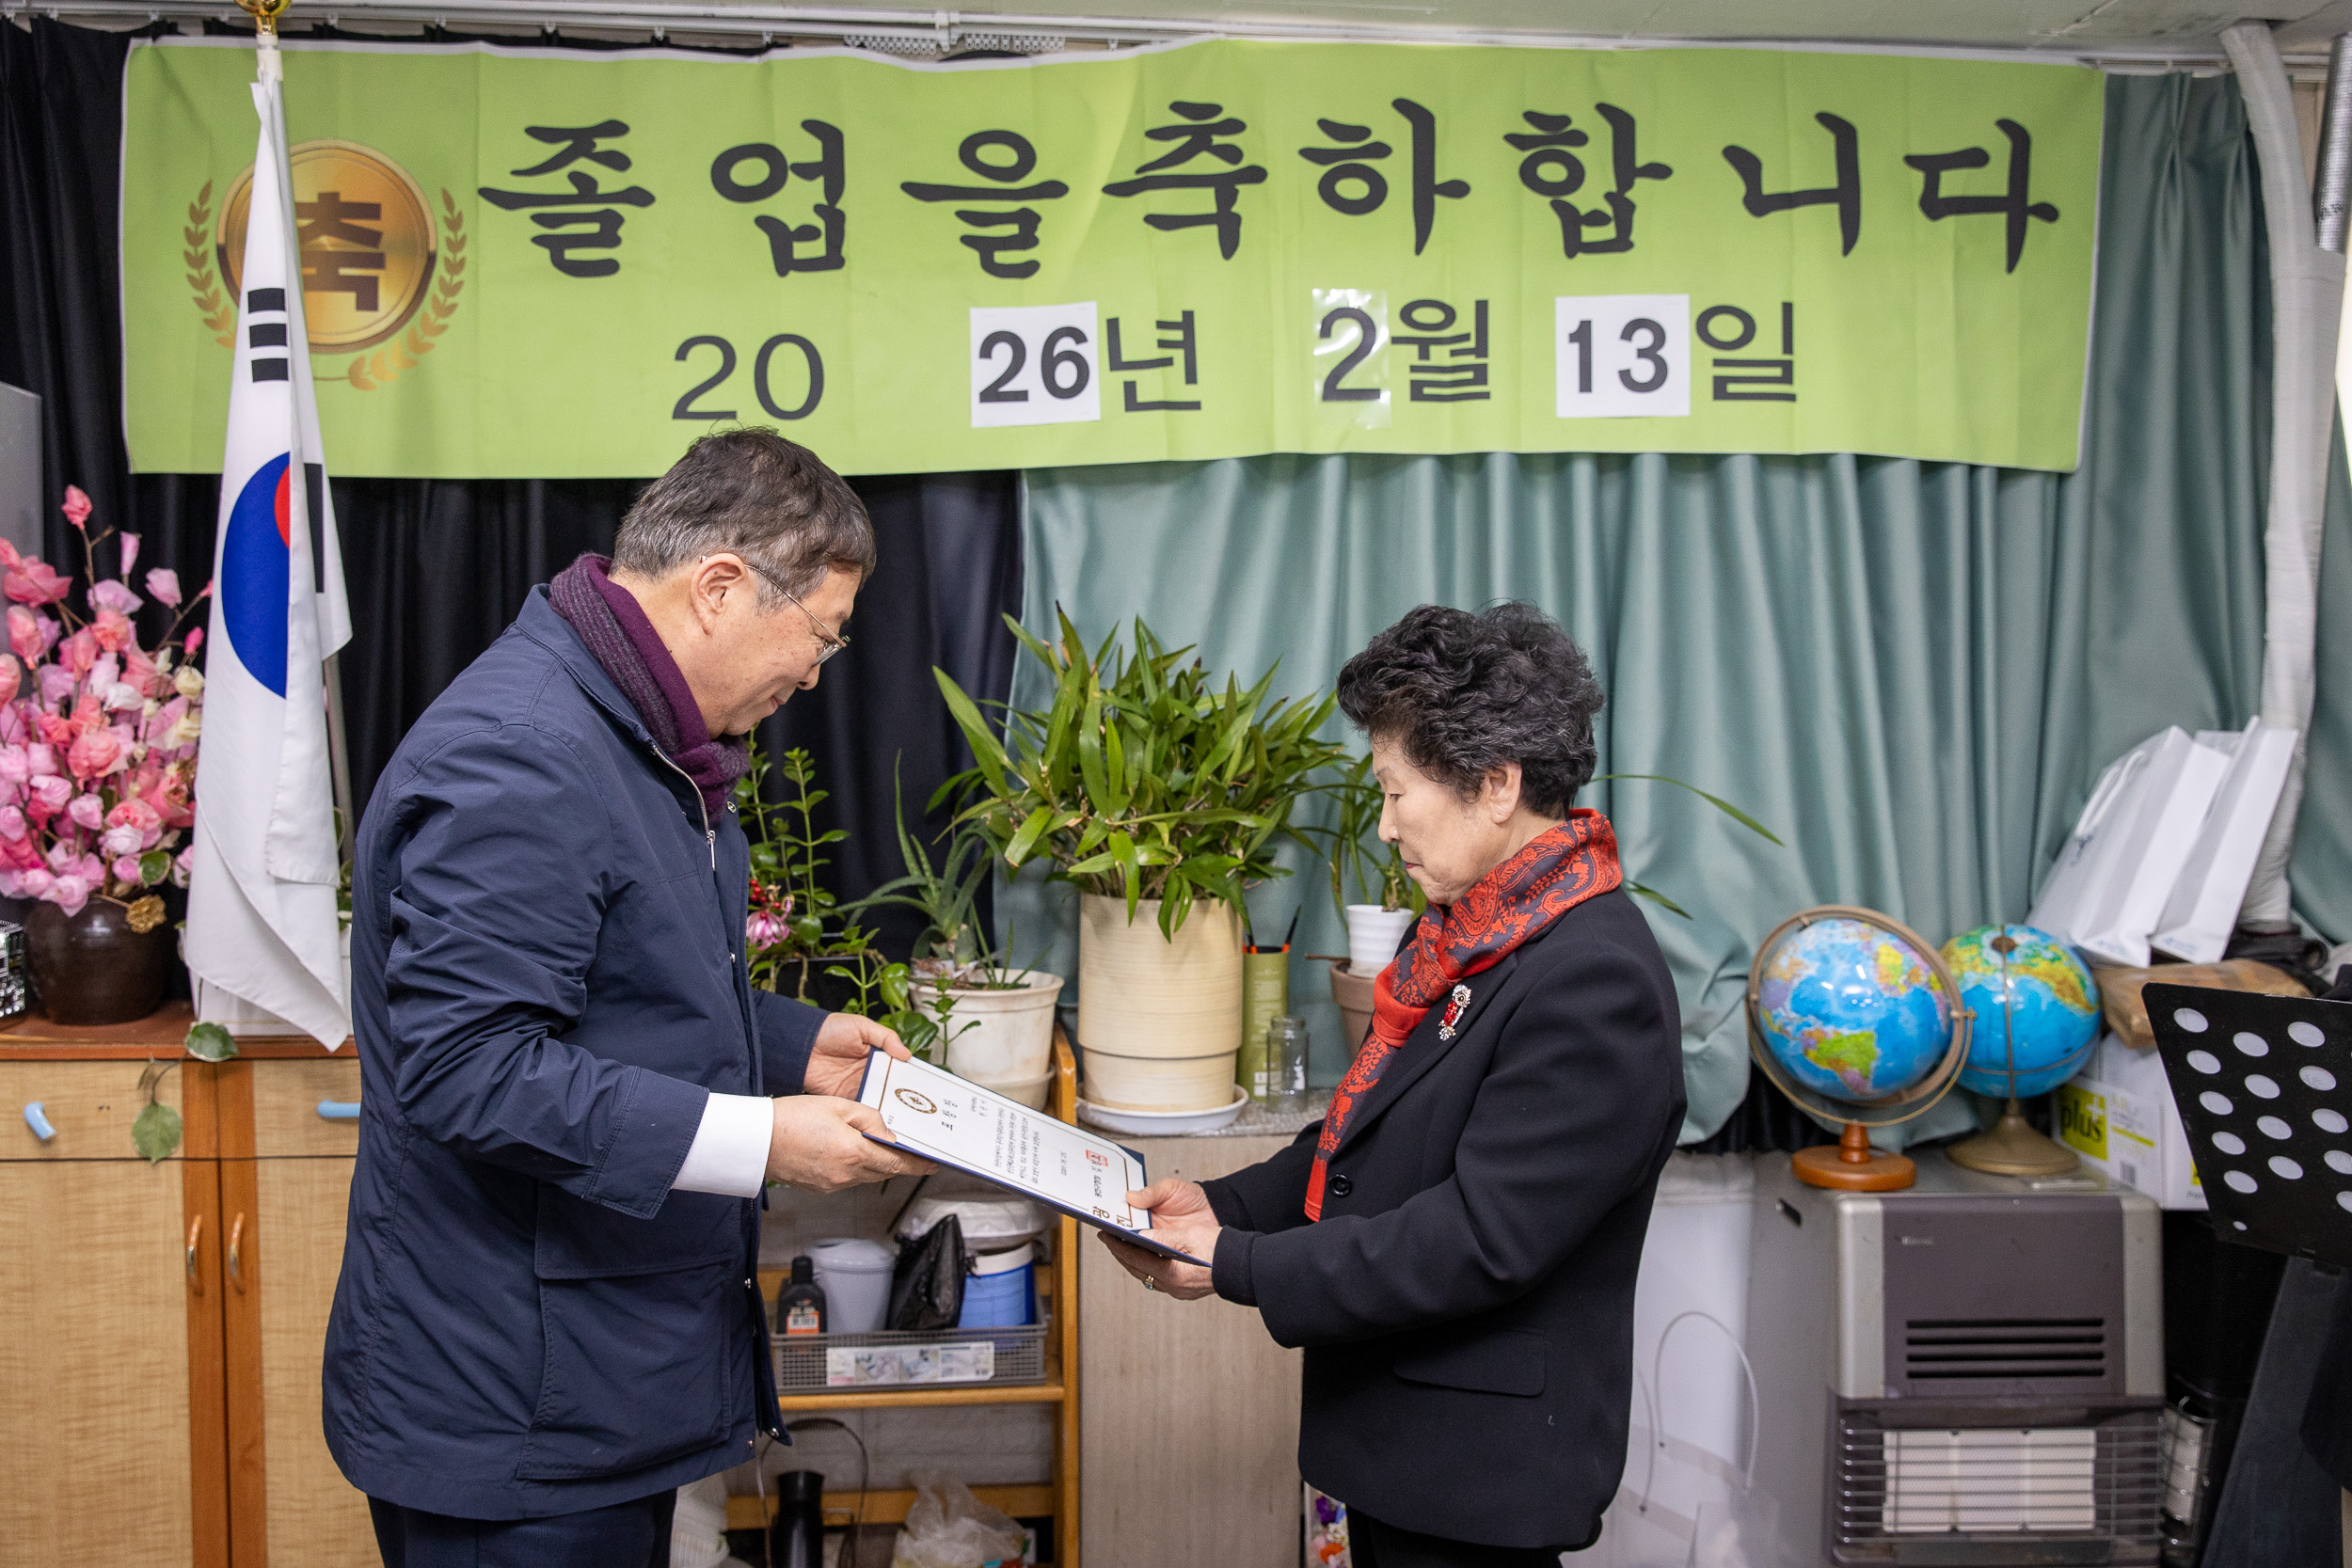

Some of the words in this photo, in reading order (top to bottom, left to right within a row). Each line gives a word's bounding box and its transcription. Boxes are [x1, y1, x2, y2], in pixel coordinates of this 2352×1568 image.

[295, 191, 387, 312] 축
[673, 333, 825, 420] 20
[2060, 1098, 2102, 1144] plus
